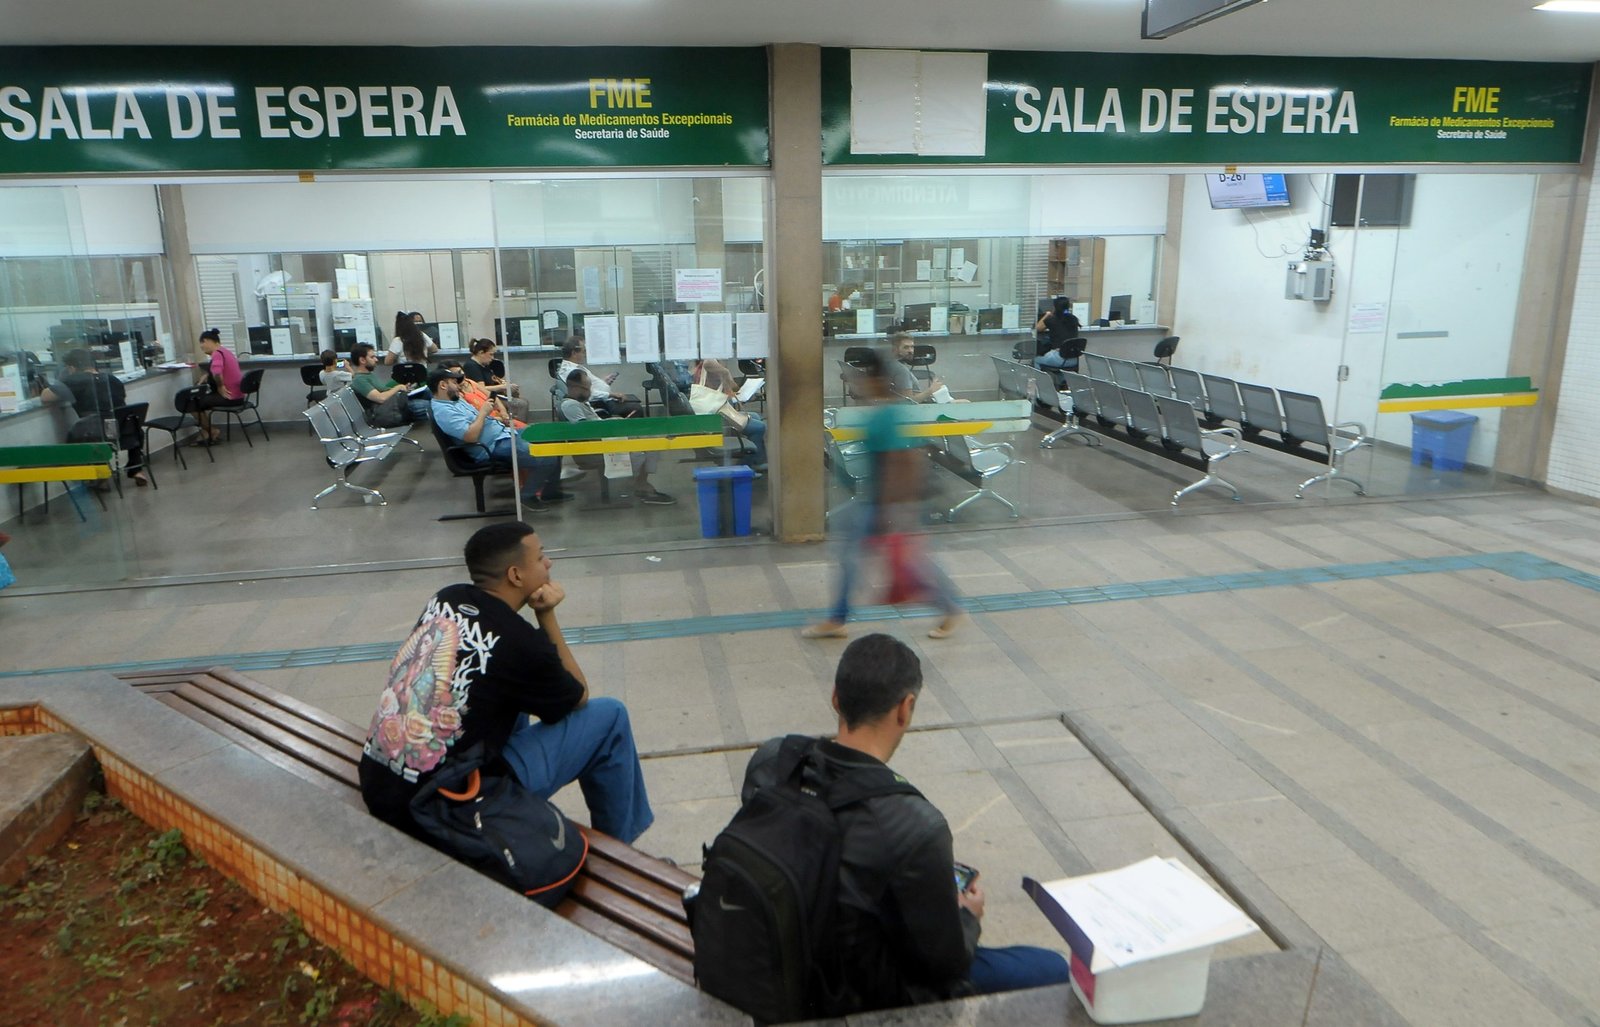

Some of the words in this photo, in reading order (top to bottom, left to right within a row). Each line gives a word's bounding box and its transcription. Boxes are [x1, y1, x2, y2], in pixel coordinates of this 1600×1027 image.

[589, 78, 653, 109] FME
[1452, 86, 1501, 113] FME
[0, 86, 152, 141] SALA
[165, 85, 241, 139] DE
[255, 86, 467, 138] ESPERA
[507, 114, 560, 127] Farmácia
[562, 115, 577, 126] de
[579, 113, 660, 126] Medicamentos
[662, 112, 733, 127] Excepcionais
[1013, 86, 1126, 134] SALA
[1140, 88, 1194, 133] DE
[1206, 90, 1359, 134] ESPERA
[1390, 115, 1428, 127] Farmácia
[1430, 116, 1440, 127] de
[1443, 116, 1501, 128] Medicamentos
[1503, 117, 1554, 129] Excepcionais
[575, 129, 624, 139] Secretaria
[626, 129, 638, 139] de
[639, 128, 670, 139] Saúde
[1437, 129, 1473, 139] Secretaria
[1474, 129, 1484, 139] de
[1485, 129, 1507, 139] Saúde
